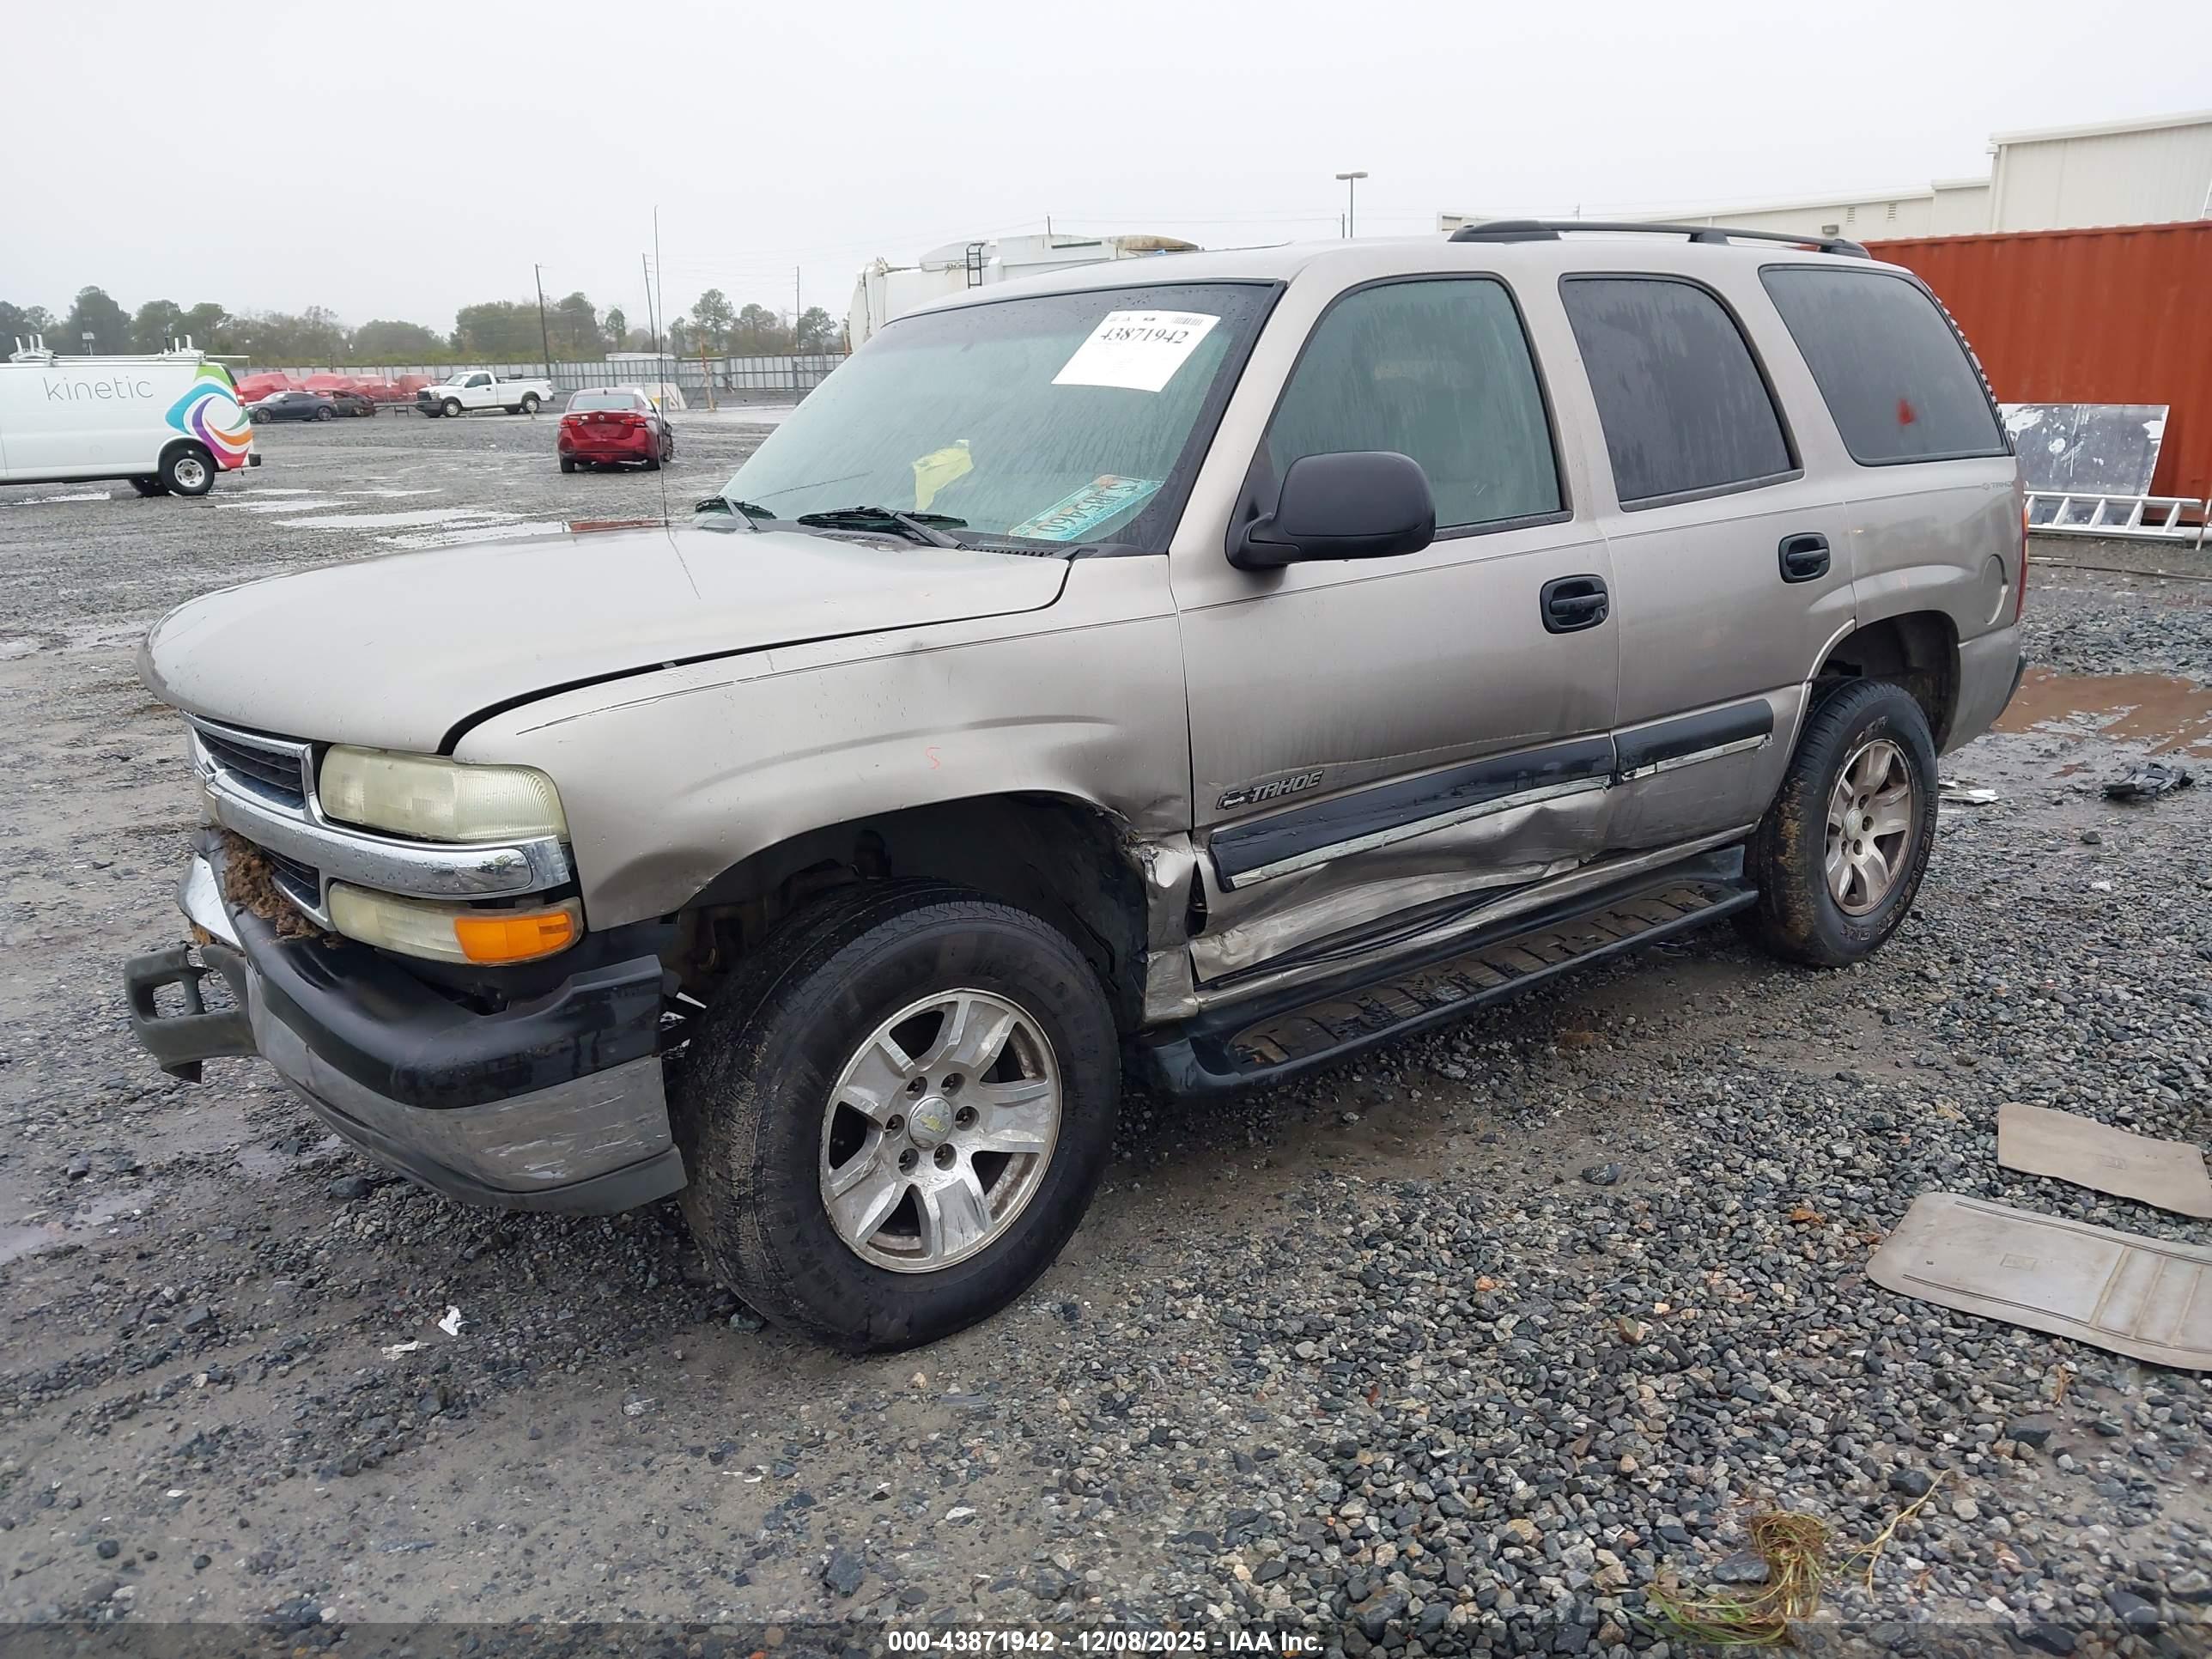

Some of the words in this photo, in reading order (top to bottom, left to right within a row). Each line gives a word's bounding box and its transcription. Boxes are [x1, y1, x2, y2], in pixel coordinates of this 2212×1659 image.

[1101, 329, 1189, 343] 43871942
[44, 375, 153, 401] kinetic
[1251, 770, 1323, 802] TAHOE
